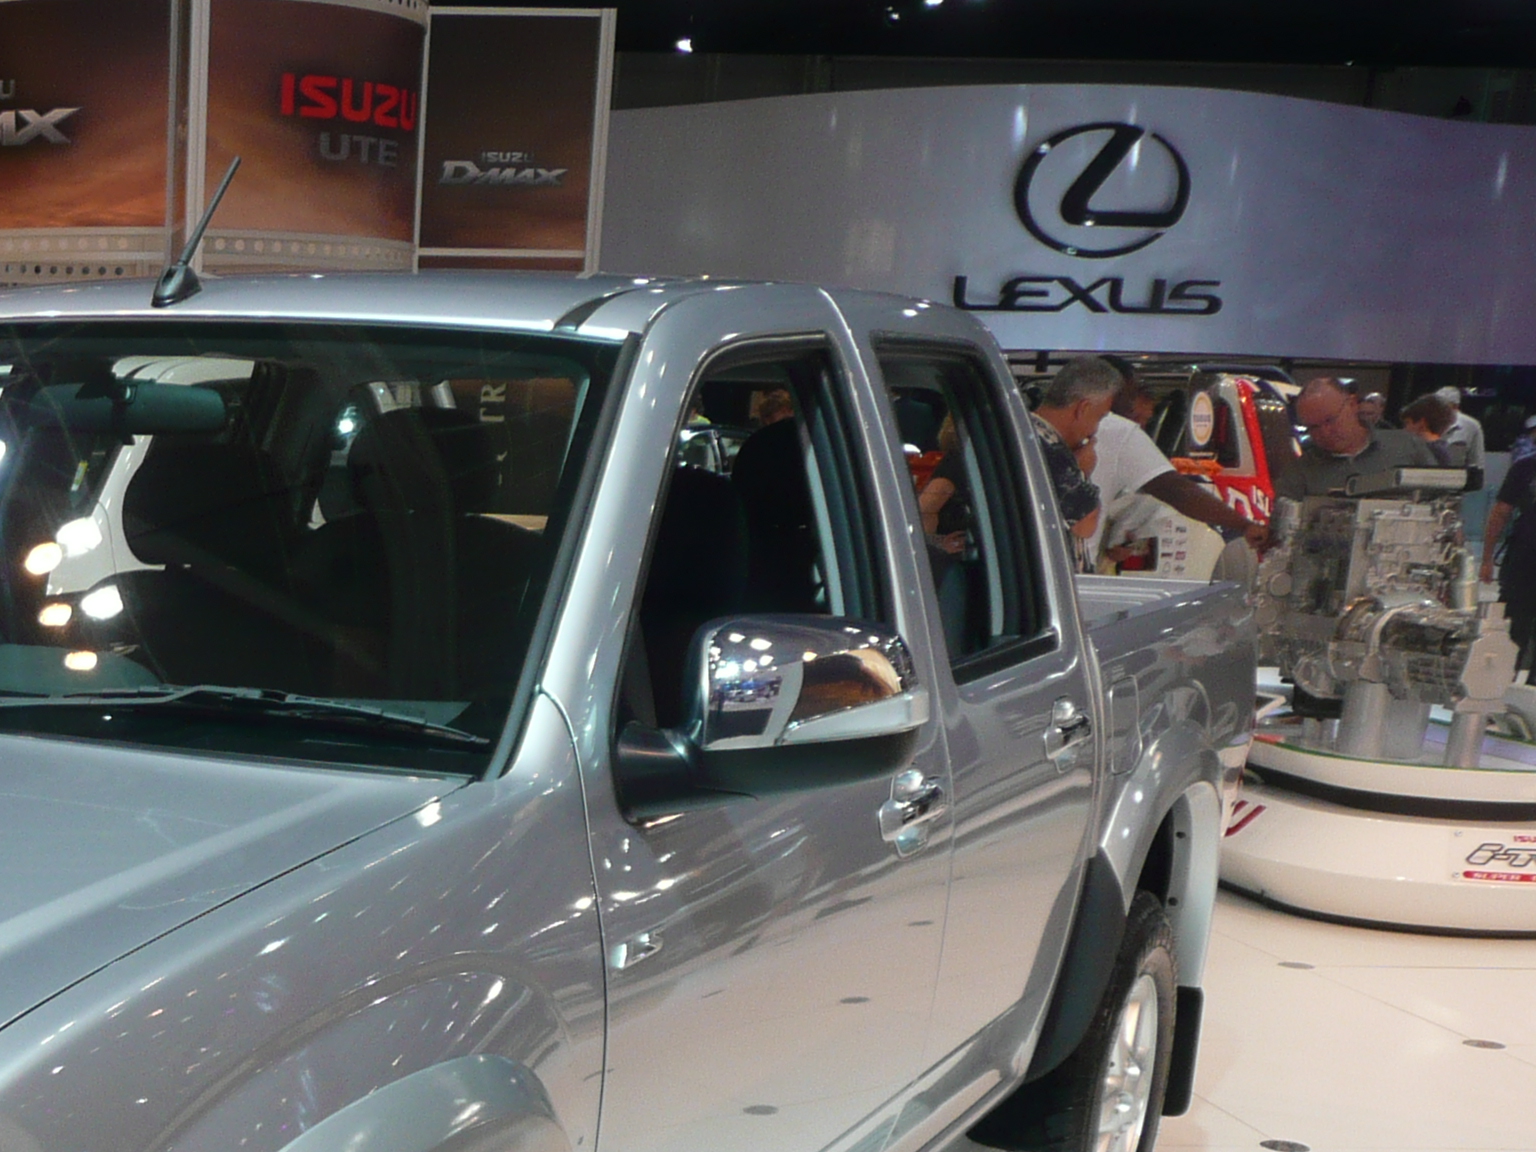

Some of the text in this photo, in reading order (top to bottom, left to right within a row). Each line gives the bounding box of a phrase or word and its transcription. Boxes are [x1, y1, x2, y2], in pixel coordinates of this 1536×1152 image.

[279, 72, 417, 132] ISUZU
[319, 130, 399, 168] UTE
[481, 151, 535, 163] ISUZU
[952, 274, 1223, 316] LEXUS
